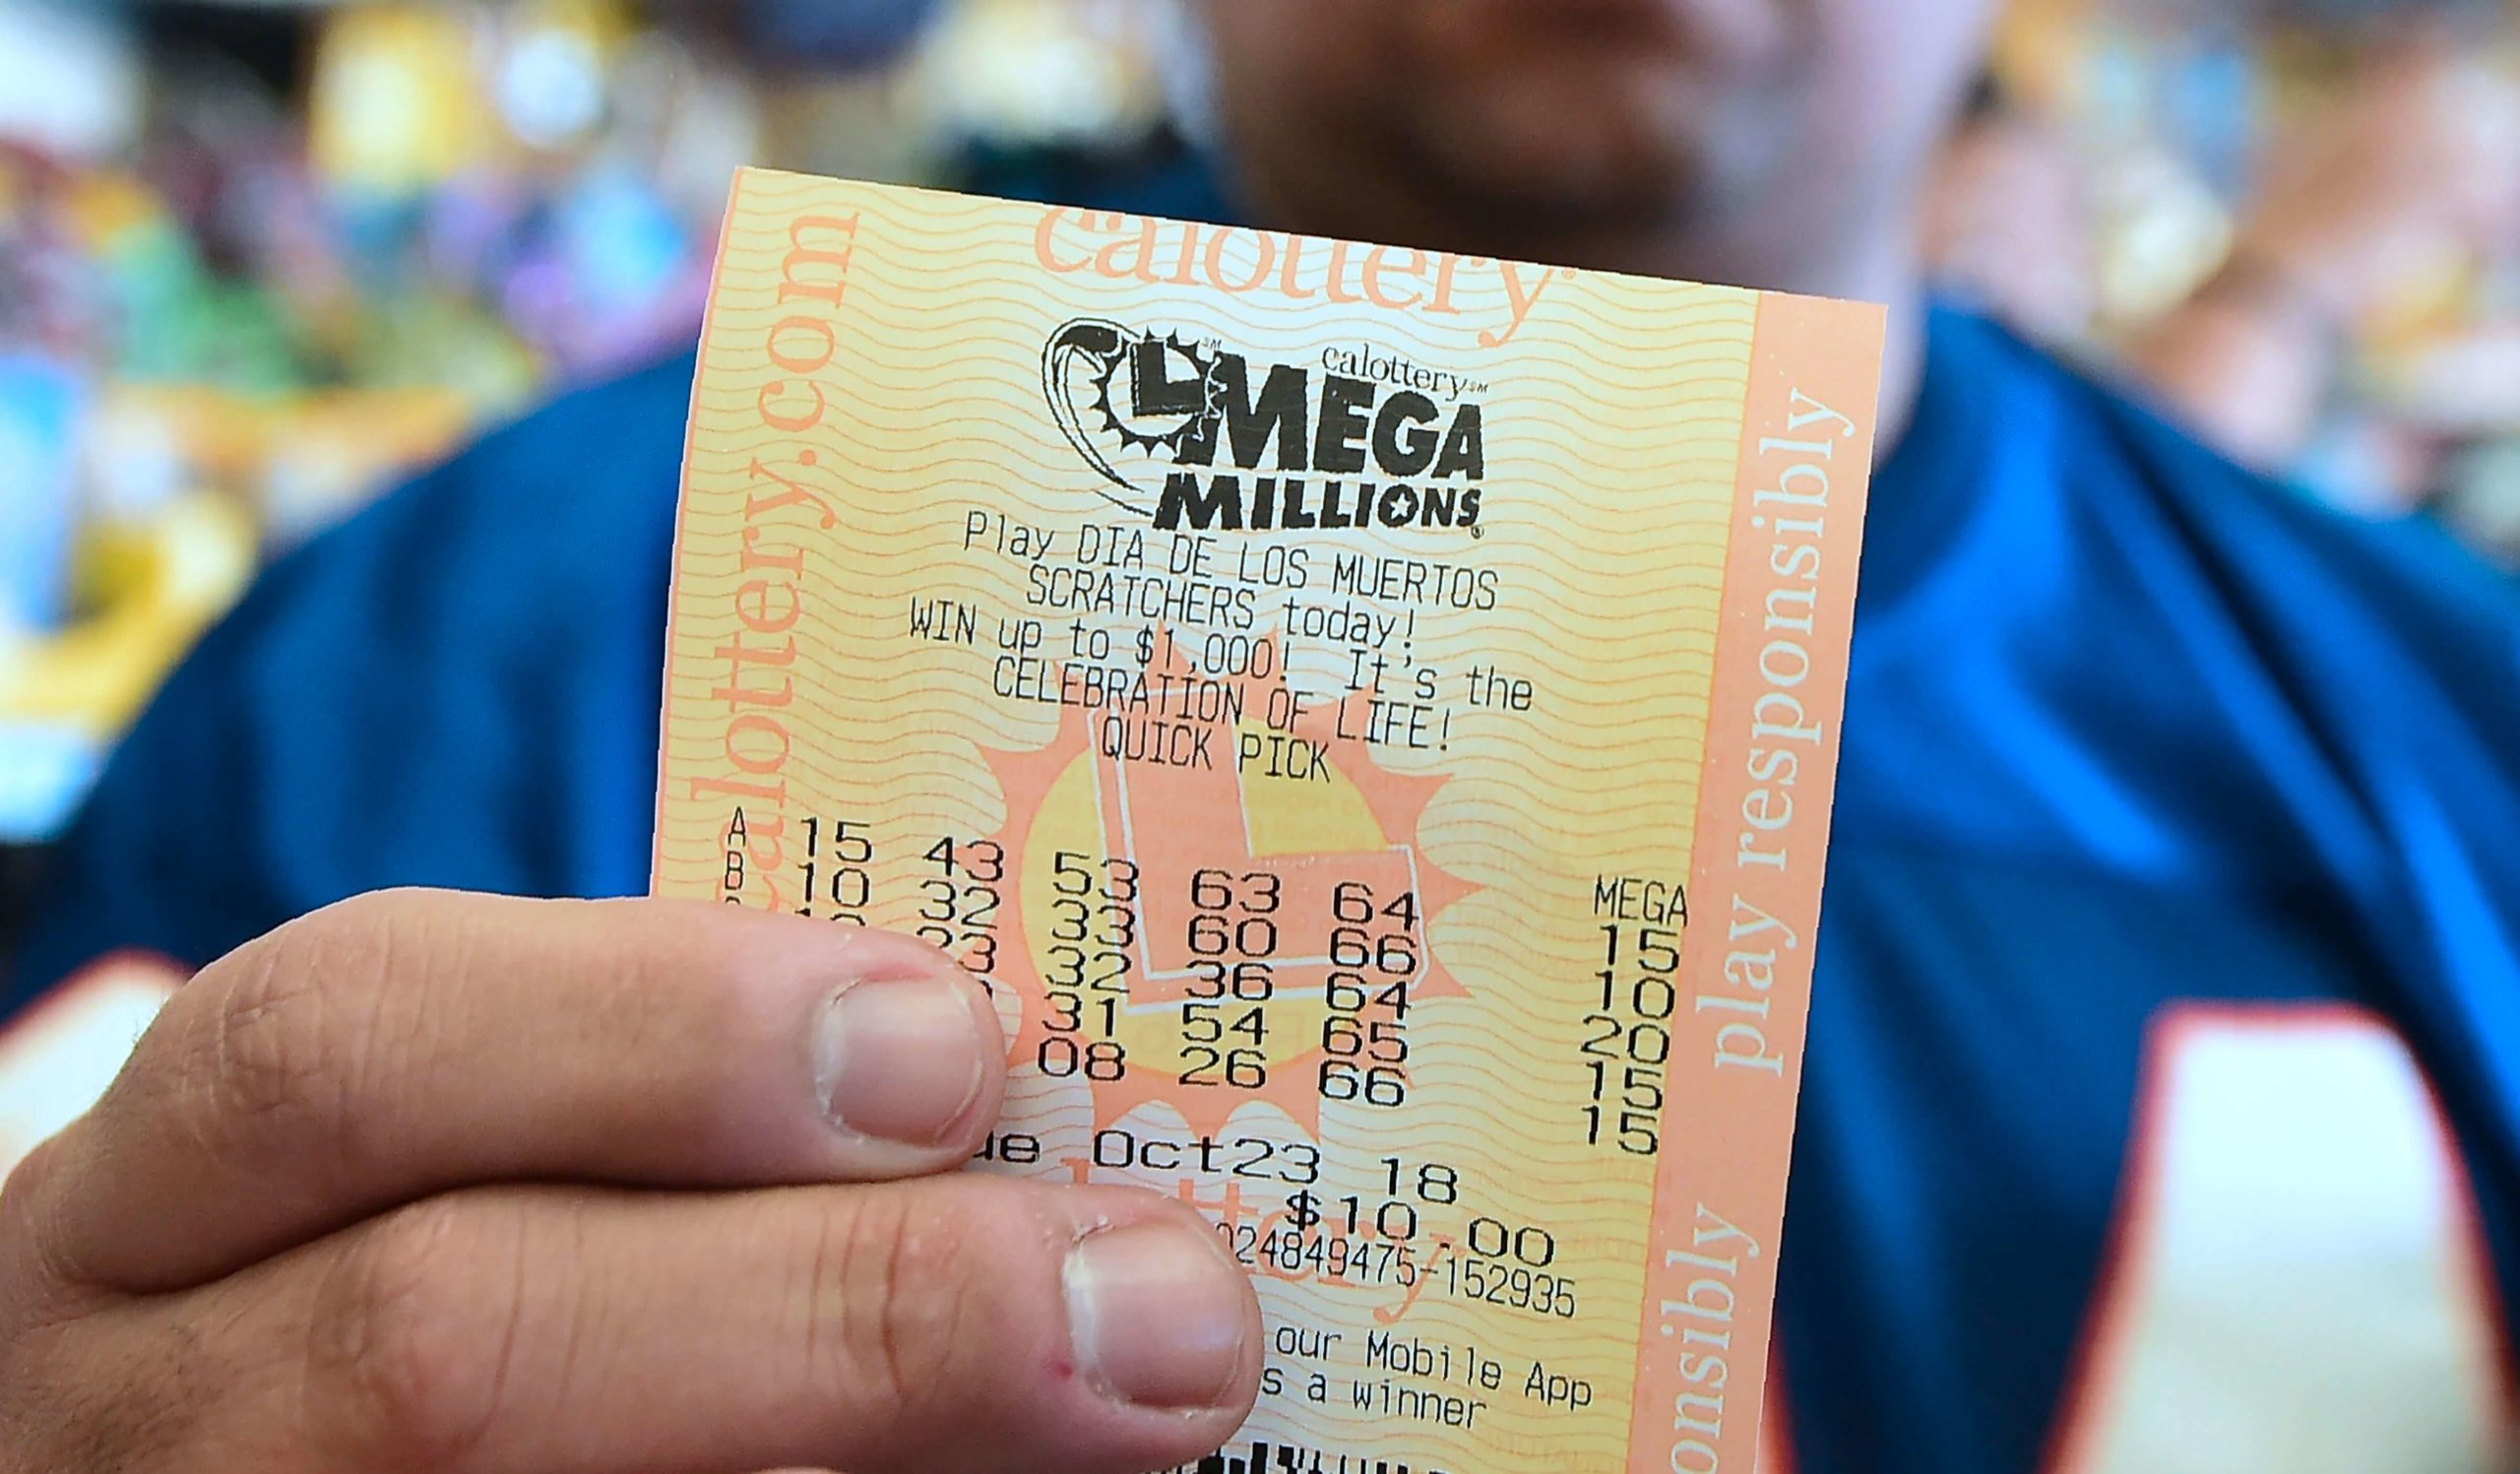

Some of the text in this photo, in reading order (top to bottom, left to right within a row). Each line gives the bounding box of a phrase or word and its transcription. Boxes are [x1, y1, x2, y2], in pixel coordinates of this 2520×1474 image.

[1171, 351, 1483, 481] MEGA
[1321, 343, 1468, 401] calottery
[1153, 473, 1481, 532] MILLIONS
[965, 511, 1497, 610] Play DIA DE LOS MUERTOS
[1027, 564, 1415, 649] SCRATCHERS today!
[911, 597, 1532, 711] WIN up to $1,000! It's the
[994, 656, 1451, 750] CELEBRATION OF LIFE!
[1102, 716, 1330, 784] QUICK PICK
[1695, 387, 1856, 1077] play responsibly
[724, 852, 743, 890] B
[798, 863, 869, 908] 10
[919, 880, 1000, 929] 32
[1052, 899, 1135, 948] 33
[1188, 915, 1277, 958] 60
[1330, 928, 1417, 976] 66
[1596, 971, 1674, 1021] 10
[728, 807, 1679, 974] A 15 43 53 63 64 15
[1595, 875, 1687, 928] MEGA
[1042, 992, 1663, 1112] 31 54 65 15
[1048, 945, 1131, 994] 32
[1185, 960, 1273, 1001] 36
[1326, 972, 1411, 1021] 64
[1581, 1015, 1670, 1065] 20
[1039, 1037, 1658, 1156] 08 26 66 15
[974, 1130, 1457, 1205] ue Oct23 18
[1282, 1189, 1553, 1268] $10.00
[1264, 1368, 1486, 1430] s a winner
[1276, 1327, 1592, 1412] our Mobile App
